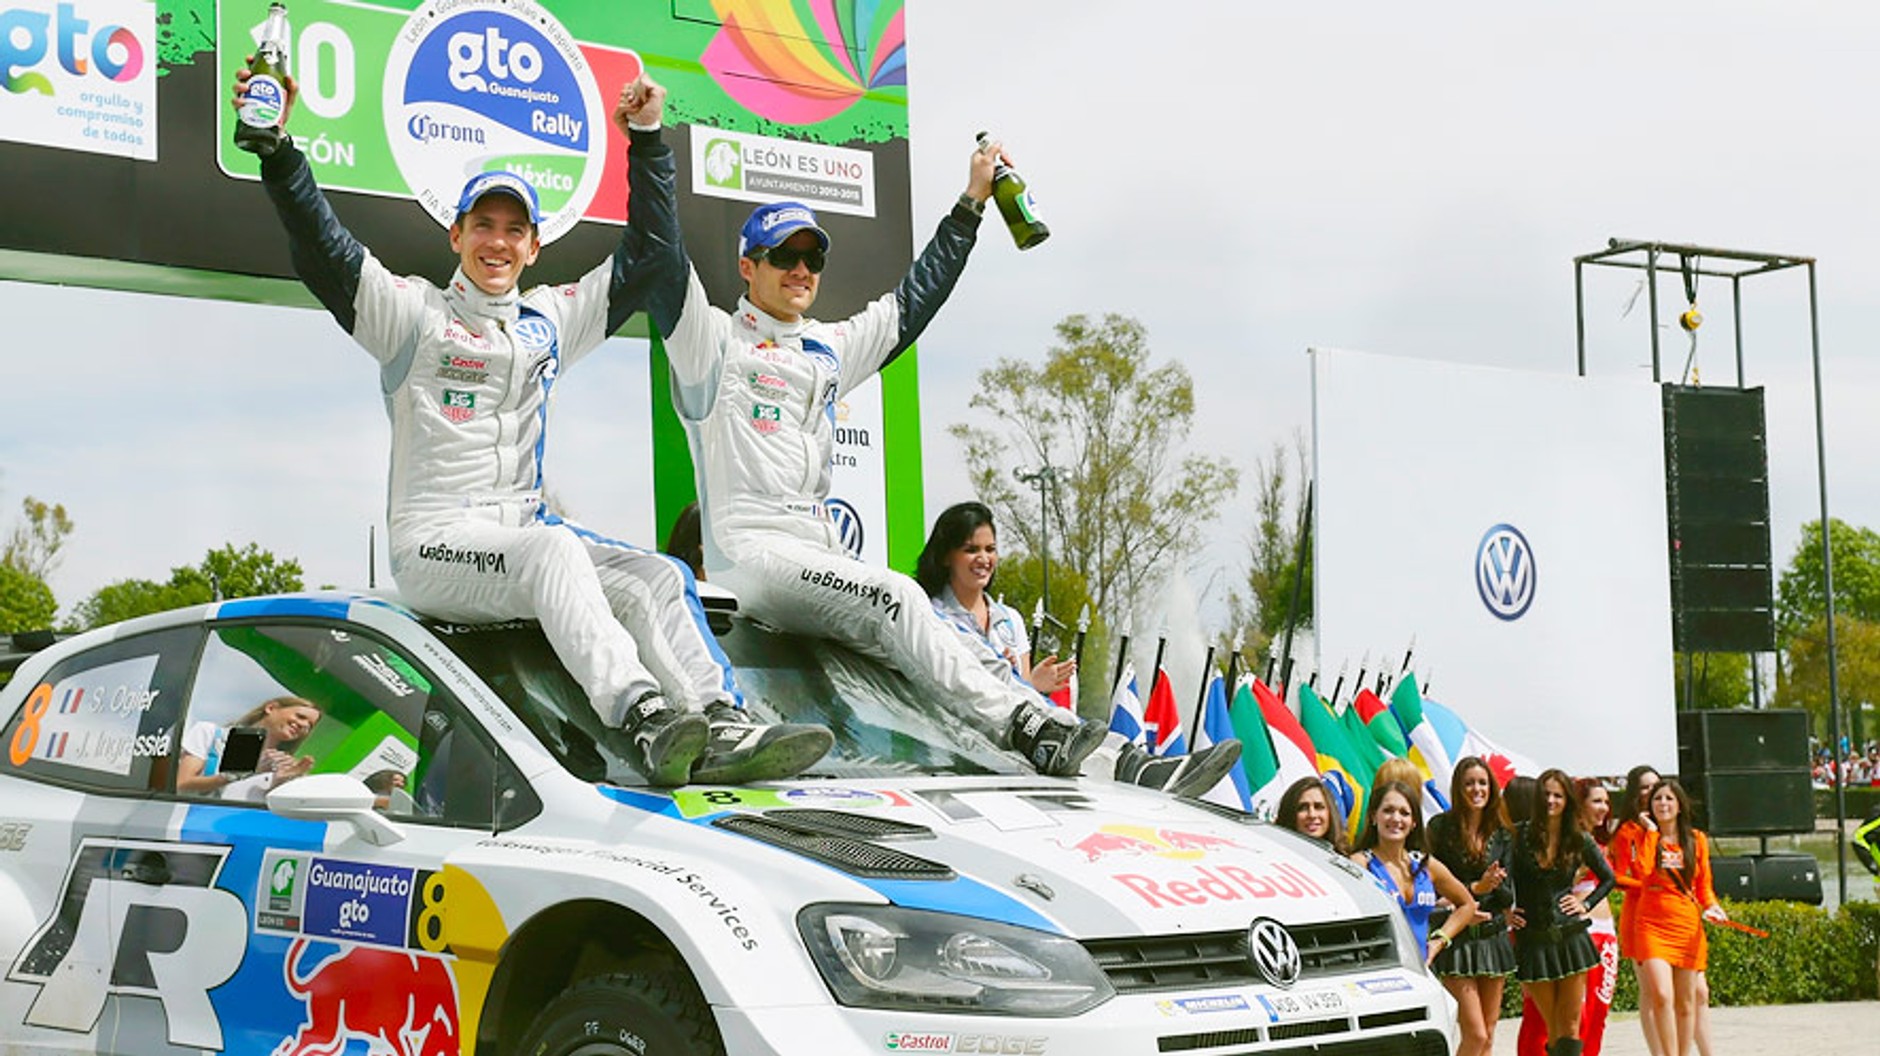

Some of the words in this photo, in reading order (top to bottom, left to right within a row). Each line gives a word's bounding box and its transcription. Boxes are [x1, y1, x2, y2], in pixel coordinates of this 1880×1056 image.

[0, 3, 144, 97] gto
[447, 26, 543, 93] gto
[79, 90, 130, 108] orgullo
[134, 100, 144, 113] y
[488, 82, 560, 104] Guanajuato
[56, 105, 144, 128] compromiso
[407, 113, 486, 144] Corona
[531, 109, 583, 142] Rally
[82, 126, 98, 139] de
[103, 129, 144, 146] todos
[742, 147, 791, 170] LEÓN
[798, 155, 819, 173] ES
[825, 161, 863, 181] UNO
[749, 177, 818, 196] AYUNTAMIENTO
[419, 543, 506, 574] Volkswagen
[109, 684, 161, 719] Ogier
[9, 683, 53, 767] 8
[703, 790, 742, 805] 8
[309, 863, 410, 899] Guanajuato
[1112, 865, 1244, 909] Red
[1215, 862, 1329, 899] Bull
[338, 899, 370, 928] gto
[416, 871, 448, 954] 8
[676, 872, 760, 952] Services
[899, 1033, 950, 1050] Castrol
[954, 1034, 1051, 1055] EDGE
